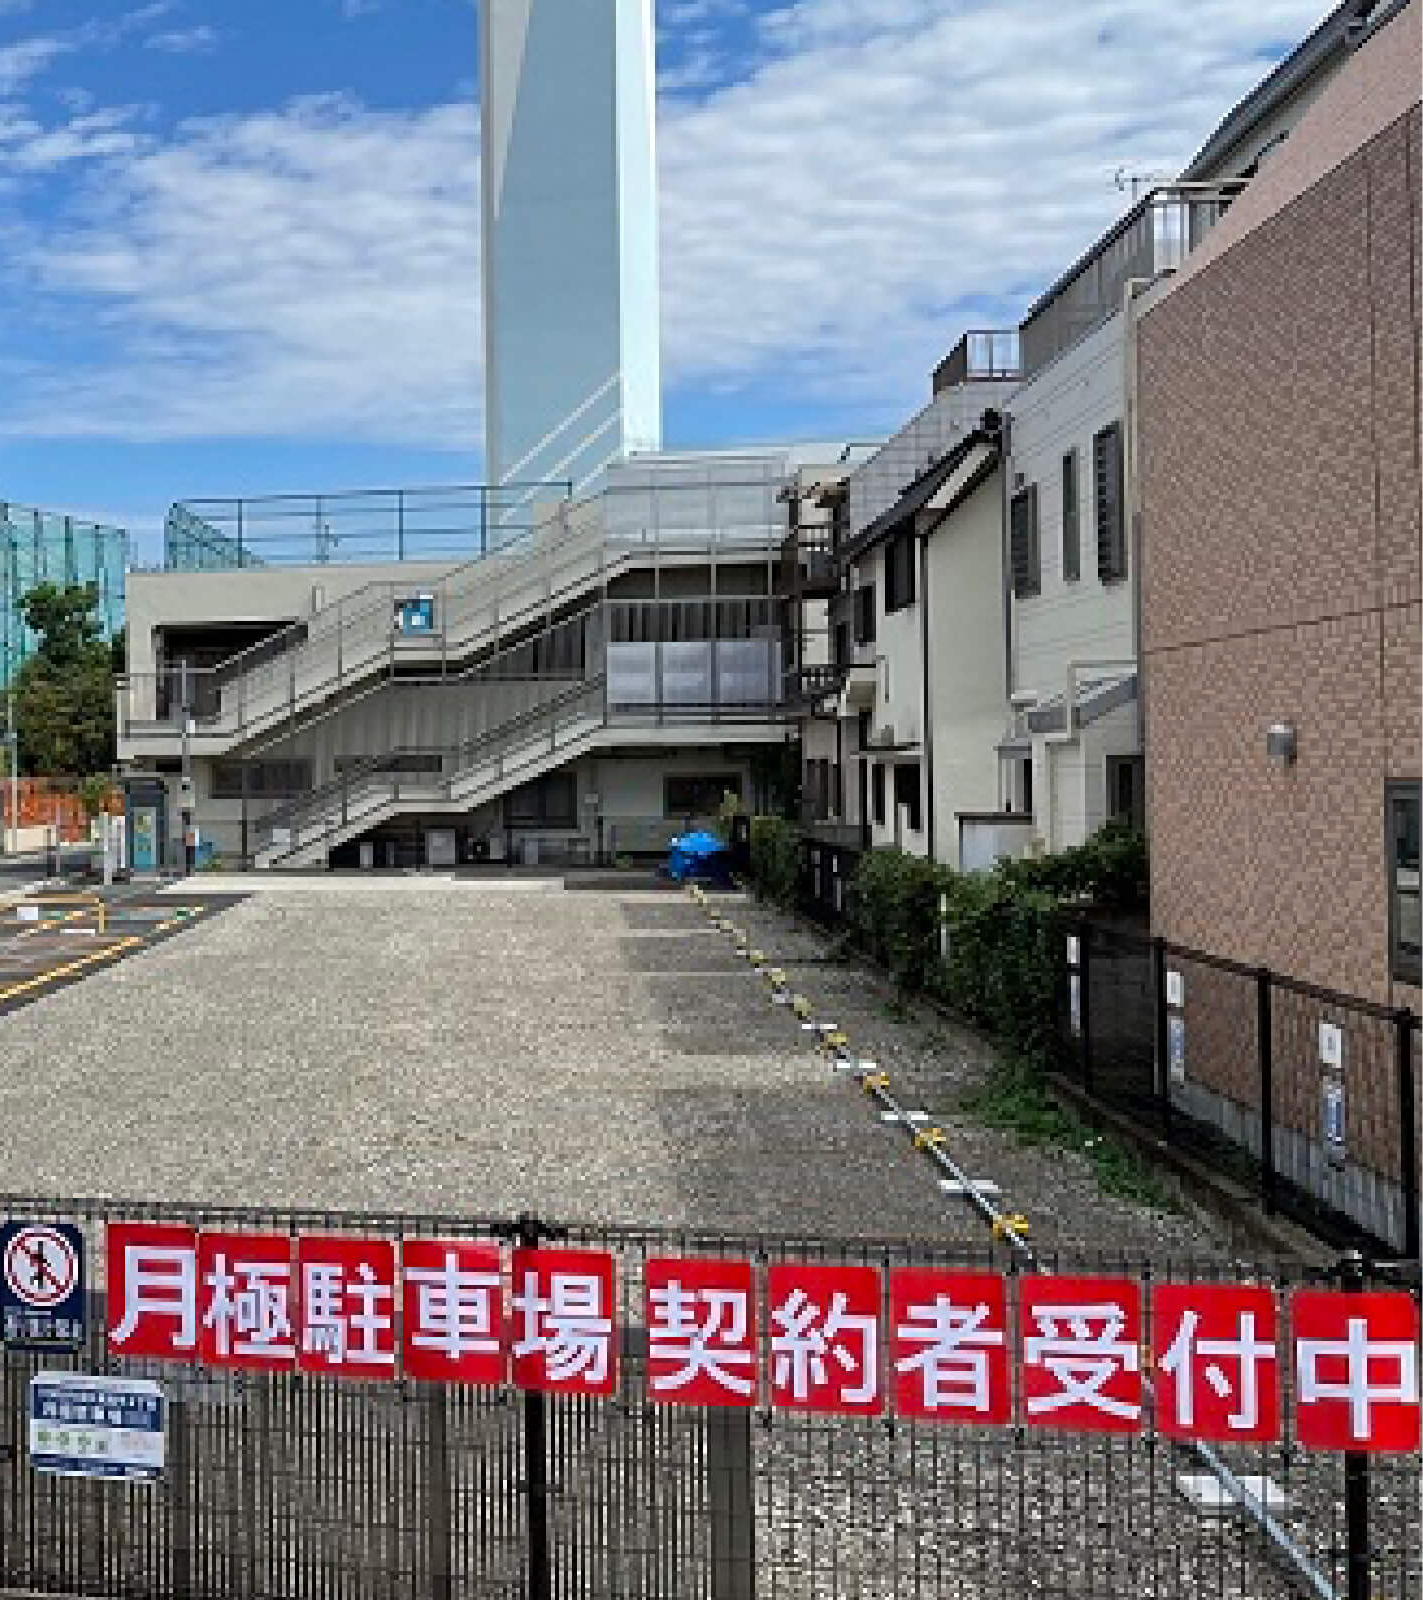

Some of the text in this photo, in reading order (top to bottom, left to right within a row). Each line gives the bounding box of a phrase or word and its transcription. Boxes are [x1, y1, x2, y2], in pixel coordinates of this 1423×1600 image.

[108, 1244, 1416, 1441] 月極駐車場 契約者受付中
